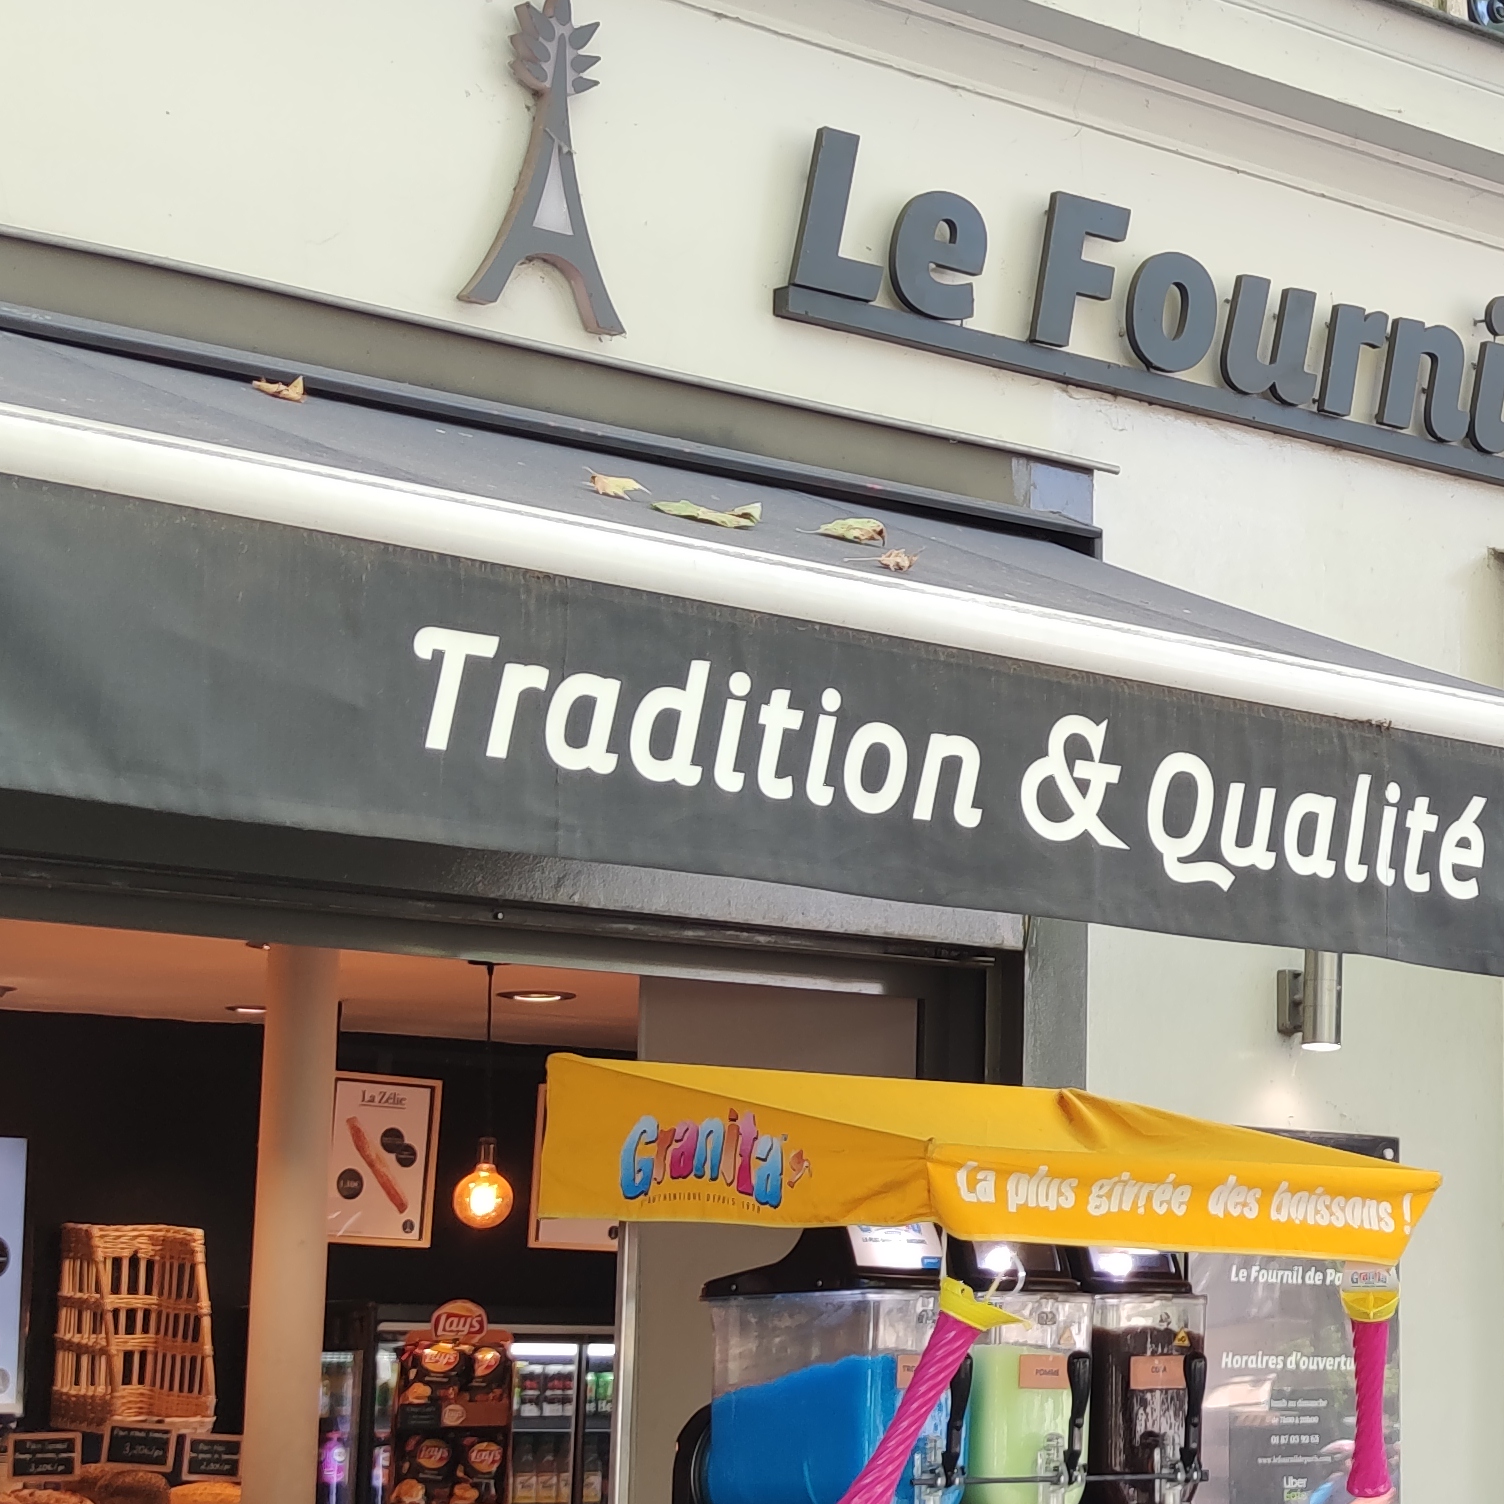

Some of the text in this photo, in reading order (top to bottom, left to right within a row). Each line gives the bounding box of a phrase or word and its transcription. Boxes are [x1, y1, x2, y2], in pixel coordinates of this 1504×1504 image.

[788, 126, 988, 320] Le
[412, 625, 1488, 901] Tradition & Qualité
[361, 1089, 376, 1104] La
[619, 1107, 784, 1210] Granita
[956, 1161, 997, 1204] La
[1007, 1165, 1078, 1213] plus
[1086, 1171, 1193, 1217] givrée
[1207, 1174, 1261, 1221] des
[1270, 1180, 1395, 1234] boissons
[1230, 1264, 1248, 1283] Le
[1250, 1264, 1303, 1285] Fournil
[1305, 1265, 1324, 1286] de
[1221, 1351, 1356, 1371] Horaires d'ouvertu
